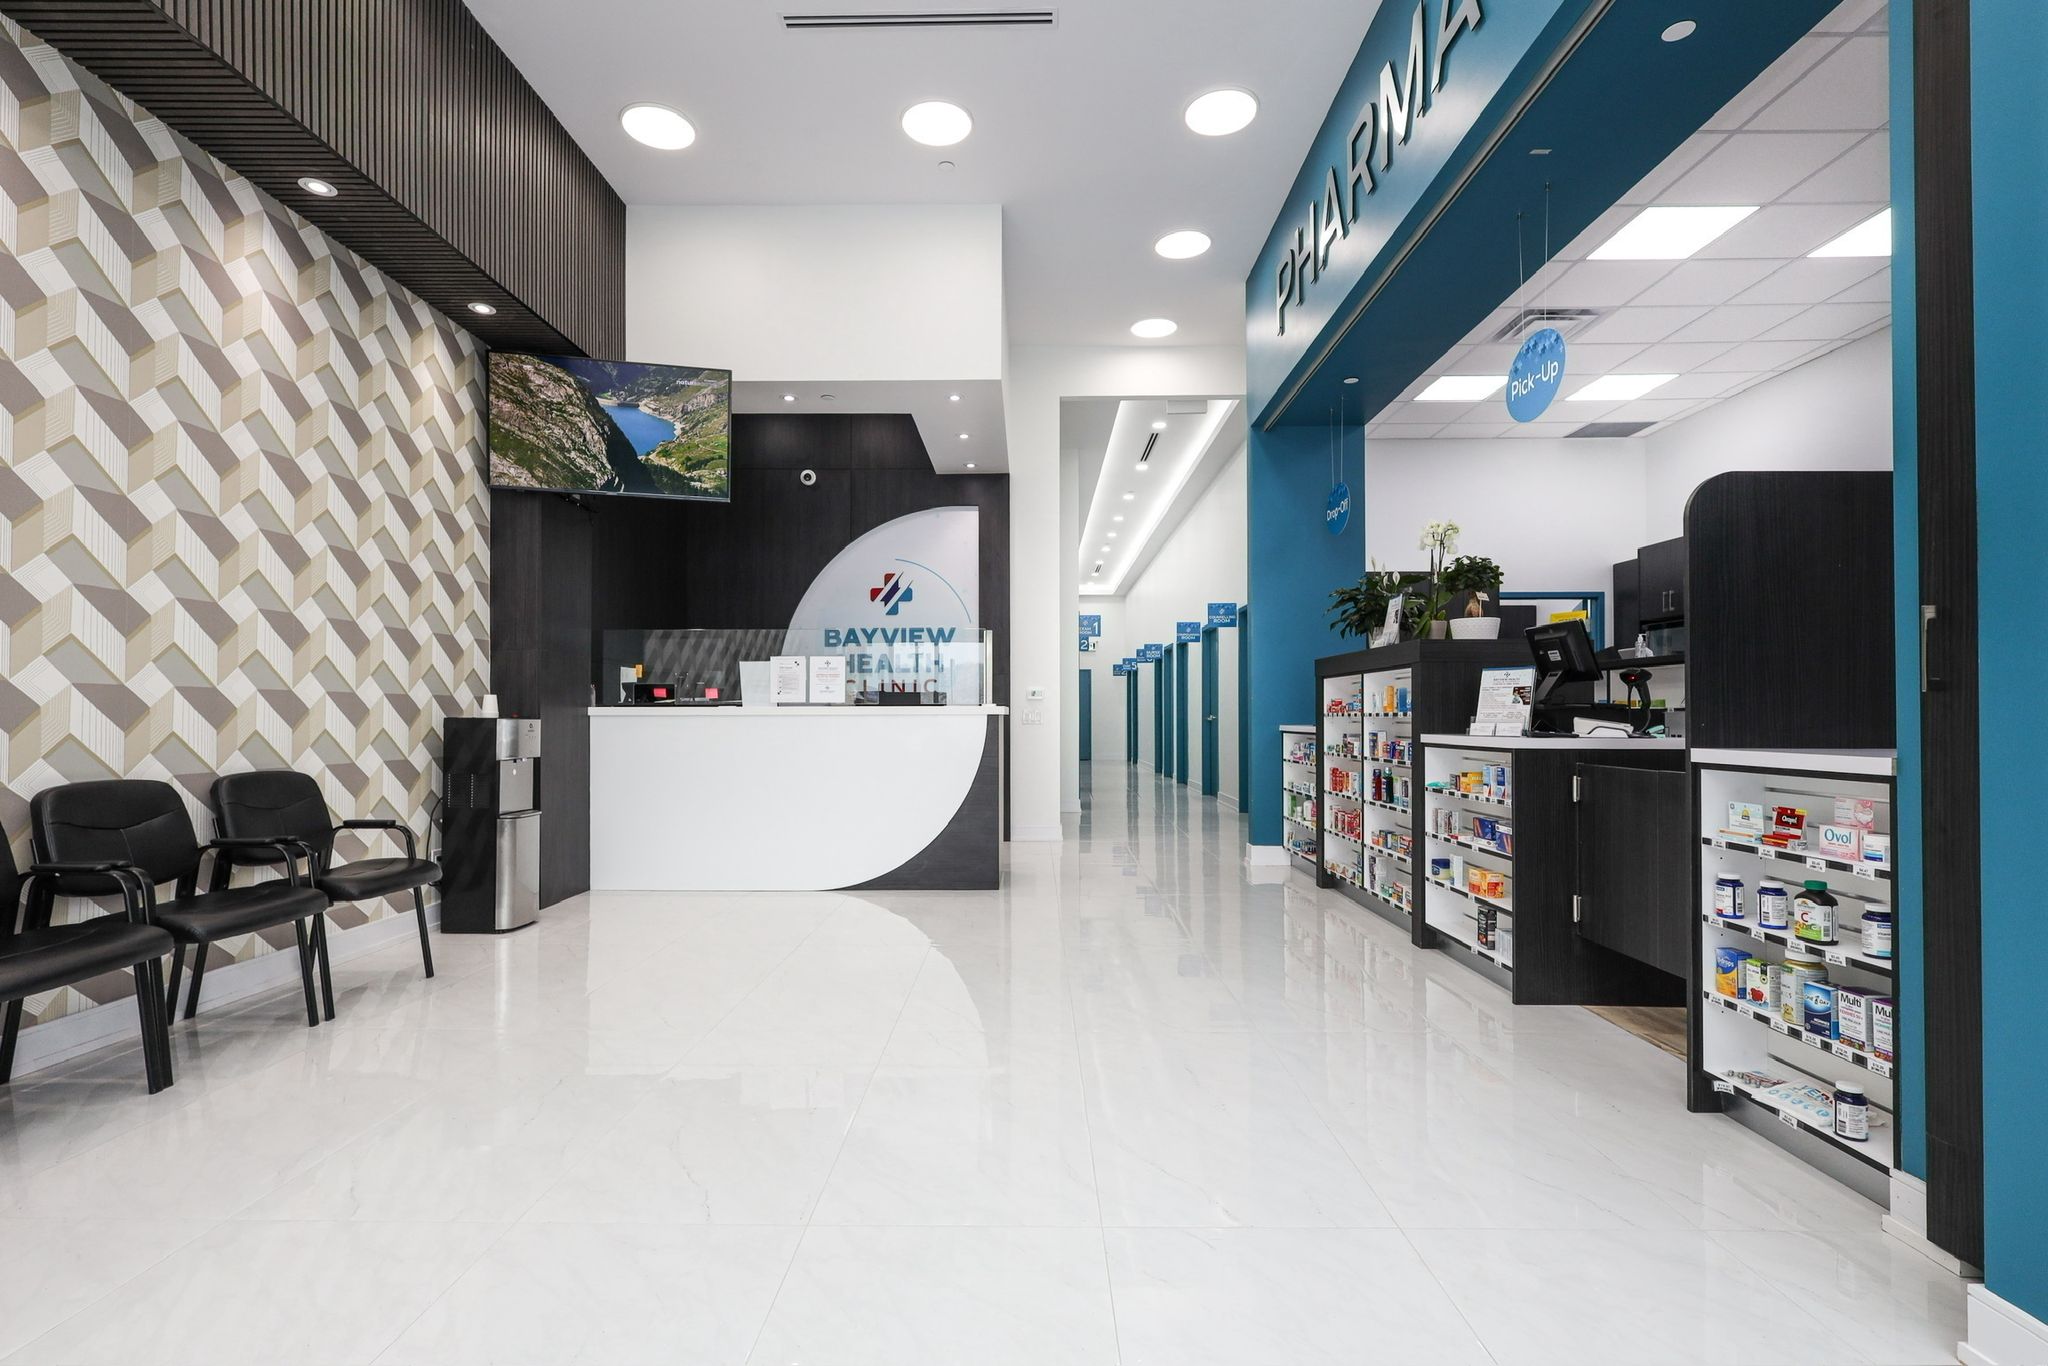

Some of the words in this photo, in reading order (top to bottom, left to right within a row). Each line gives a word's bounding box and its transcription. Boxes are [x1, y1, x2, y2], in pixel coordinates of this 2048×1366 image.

[1276, 0, 1480, 336] PHARMA
[1511, 360, 1559, 401] Pick-Up
[1326, 498, 1349, 521] Drop-Off
[1093, 621, 1099, 635] 1
[824, 627, 956, 648] BAYVIEW
[1080, 640, 1088, 650] 2
[1131, 662, 1137, 670] 5
[1824, 828, 1852, 844] Ovol
[1801, 912, 1809, 922] C
[1840, 993, 1862, 1008] Multi
